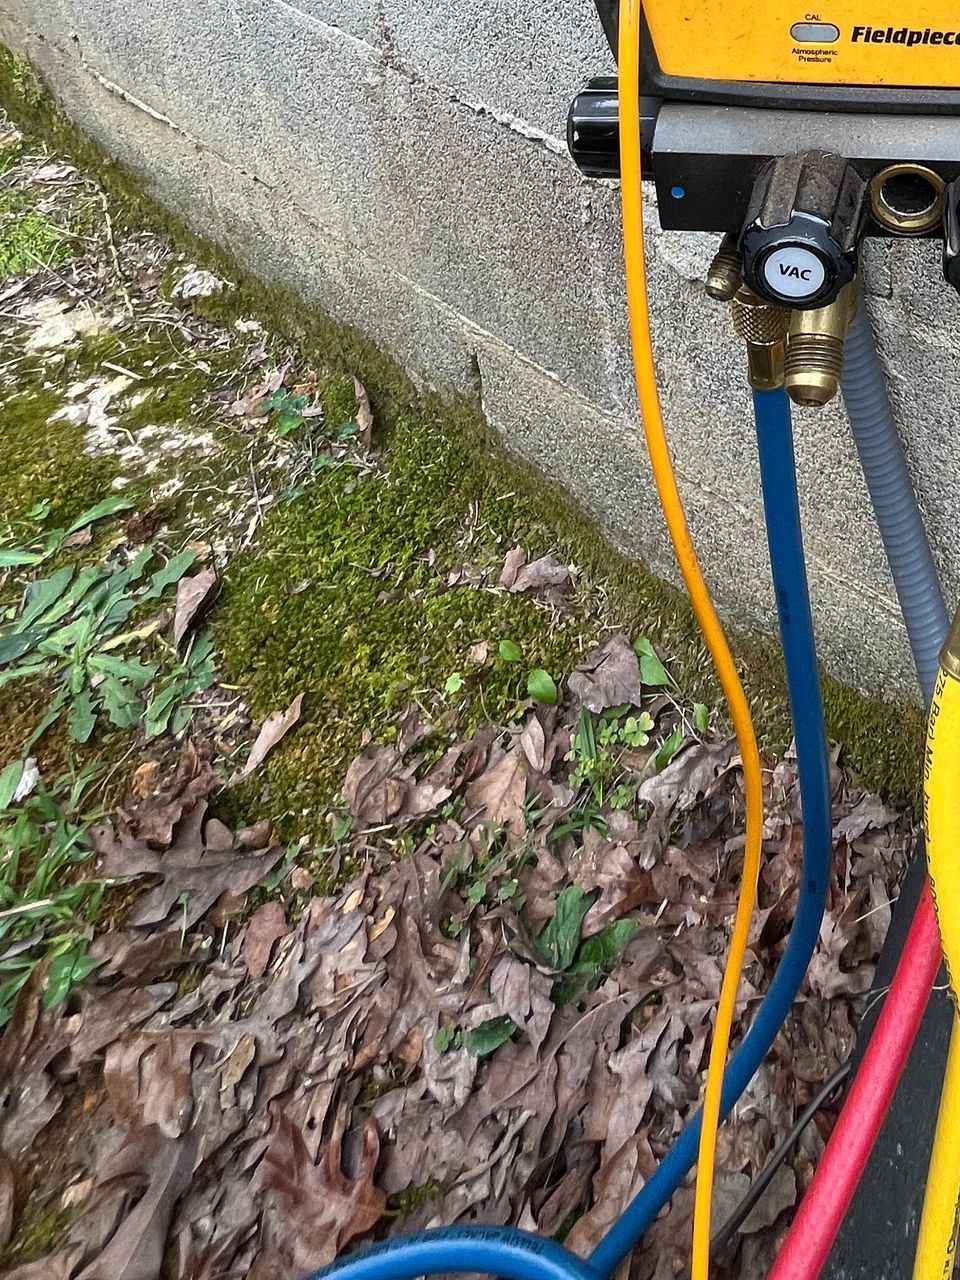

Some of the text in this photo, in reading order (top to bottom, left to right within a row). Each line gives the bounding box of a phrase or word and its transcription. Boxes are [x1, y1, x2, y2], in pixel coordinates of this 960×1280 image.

[805, 13, 822, 21] CAL
[791, 47, 838, 57] Atmospheric
[798, 55, 832, 64] Pressure
[778, 263, 812, 283] VAC
